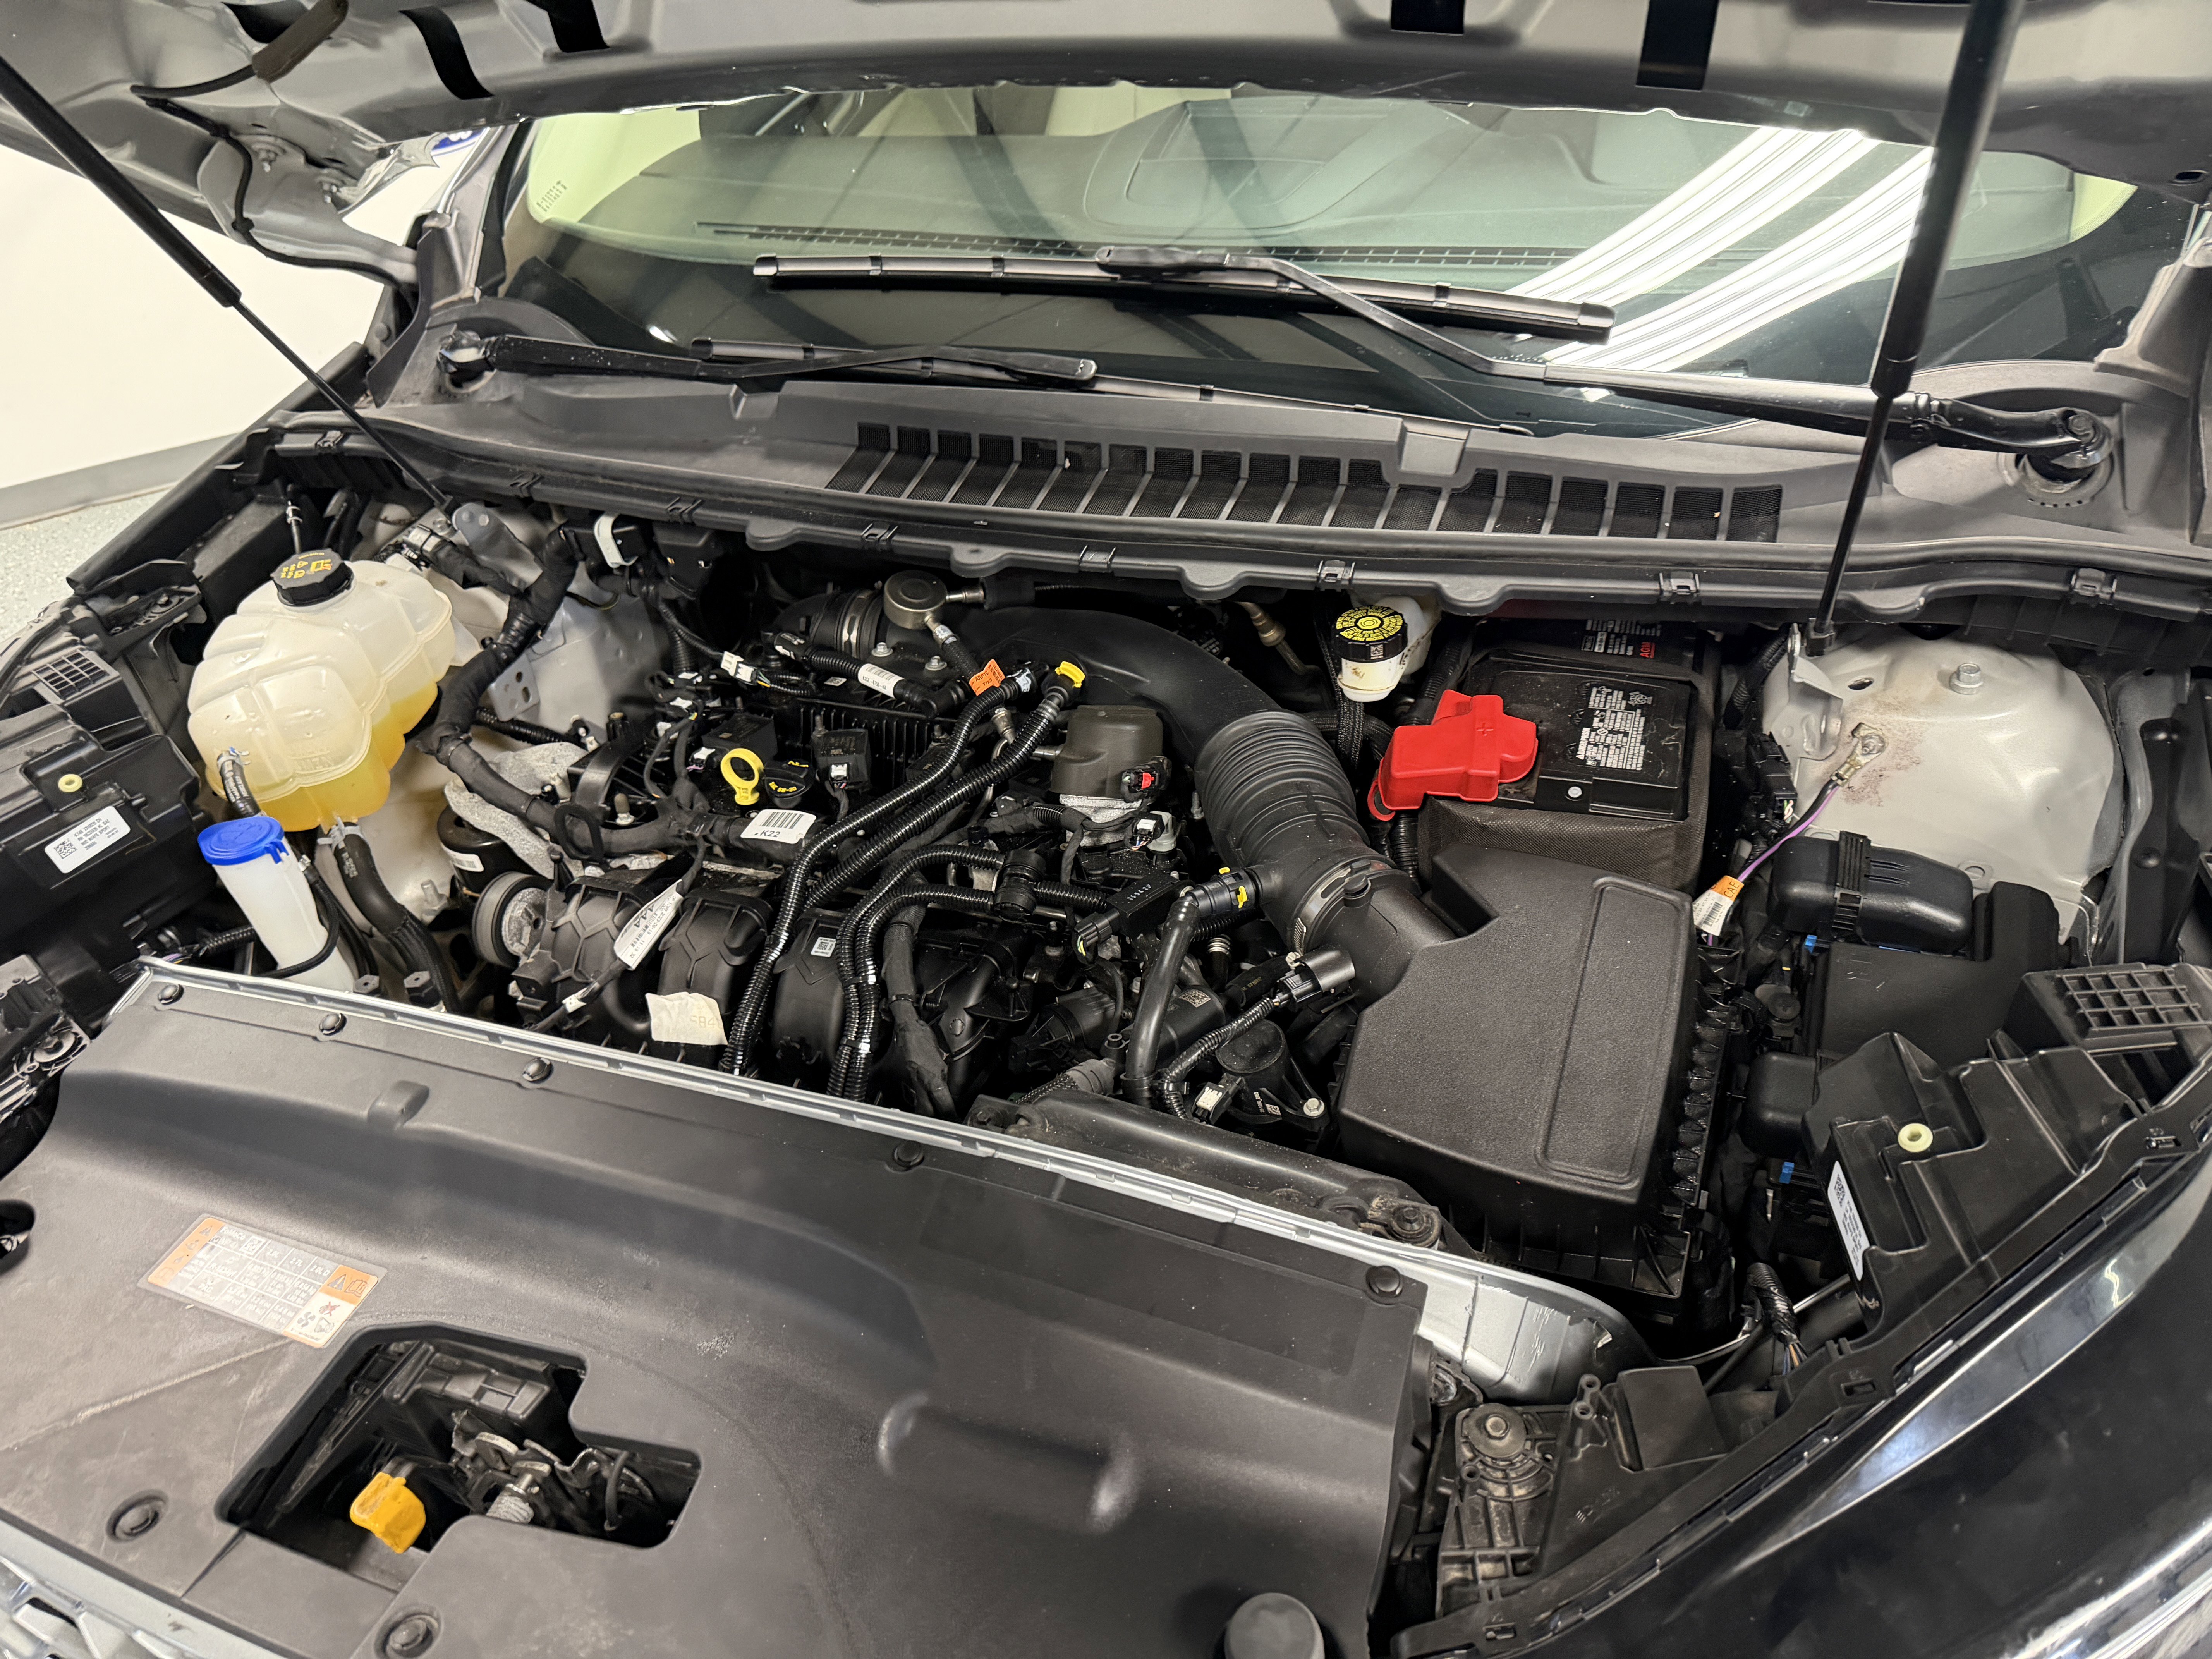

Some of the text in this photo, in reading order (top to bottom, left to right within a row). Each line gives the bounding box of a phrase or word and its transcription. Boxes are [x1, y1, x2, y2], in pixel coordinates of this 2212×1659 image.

[1640, 641, 1651, 658] AGM
[1724, 881, 1740, 898] CAE
[221, 1226, 247, 1240] FoMoCo
[290, 1258, 304, 1266] 2.7L
[198, 1283, 213, 1293] PAG
